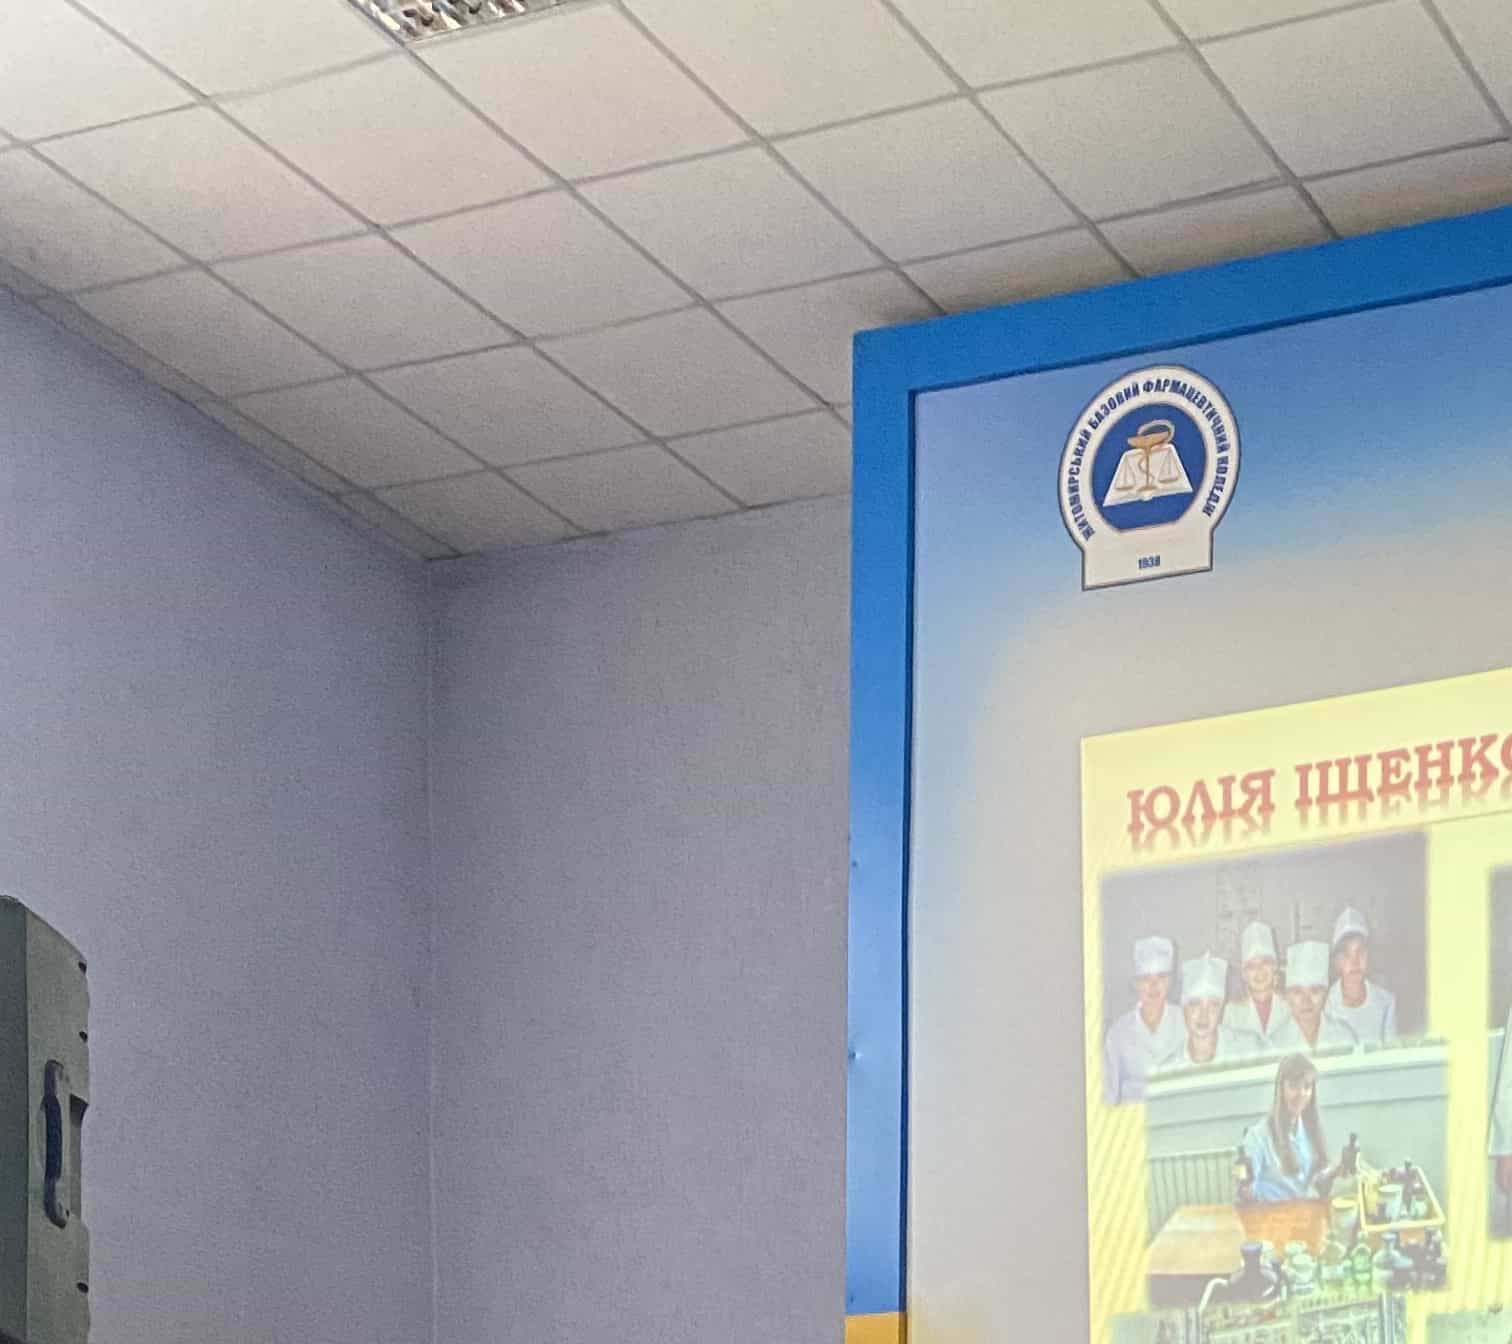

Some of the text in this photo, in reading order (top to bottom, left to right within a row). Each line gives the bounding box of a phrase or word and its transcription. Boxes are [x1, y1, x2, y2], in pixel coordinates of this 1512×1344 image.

[1088, 382, 1140, 430] БАЗОВИЙ
[1142, 378, 1231, 454] ФАРМАЦЕВТИЧНИЙ
[1138, 555, 1161, 569] 1938
[1127, 768, 1276, 836] ЮЛІЯ
